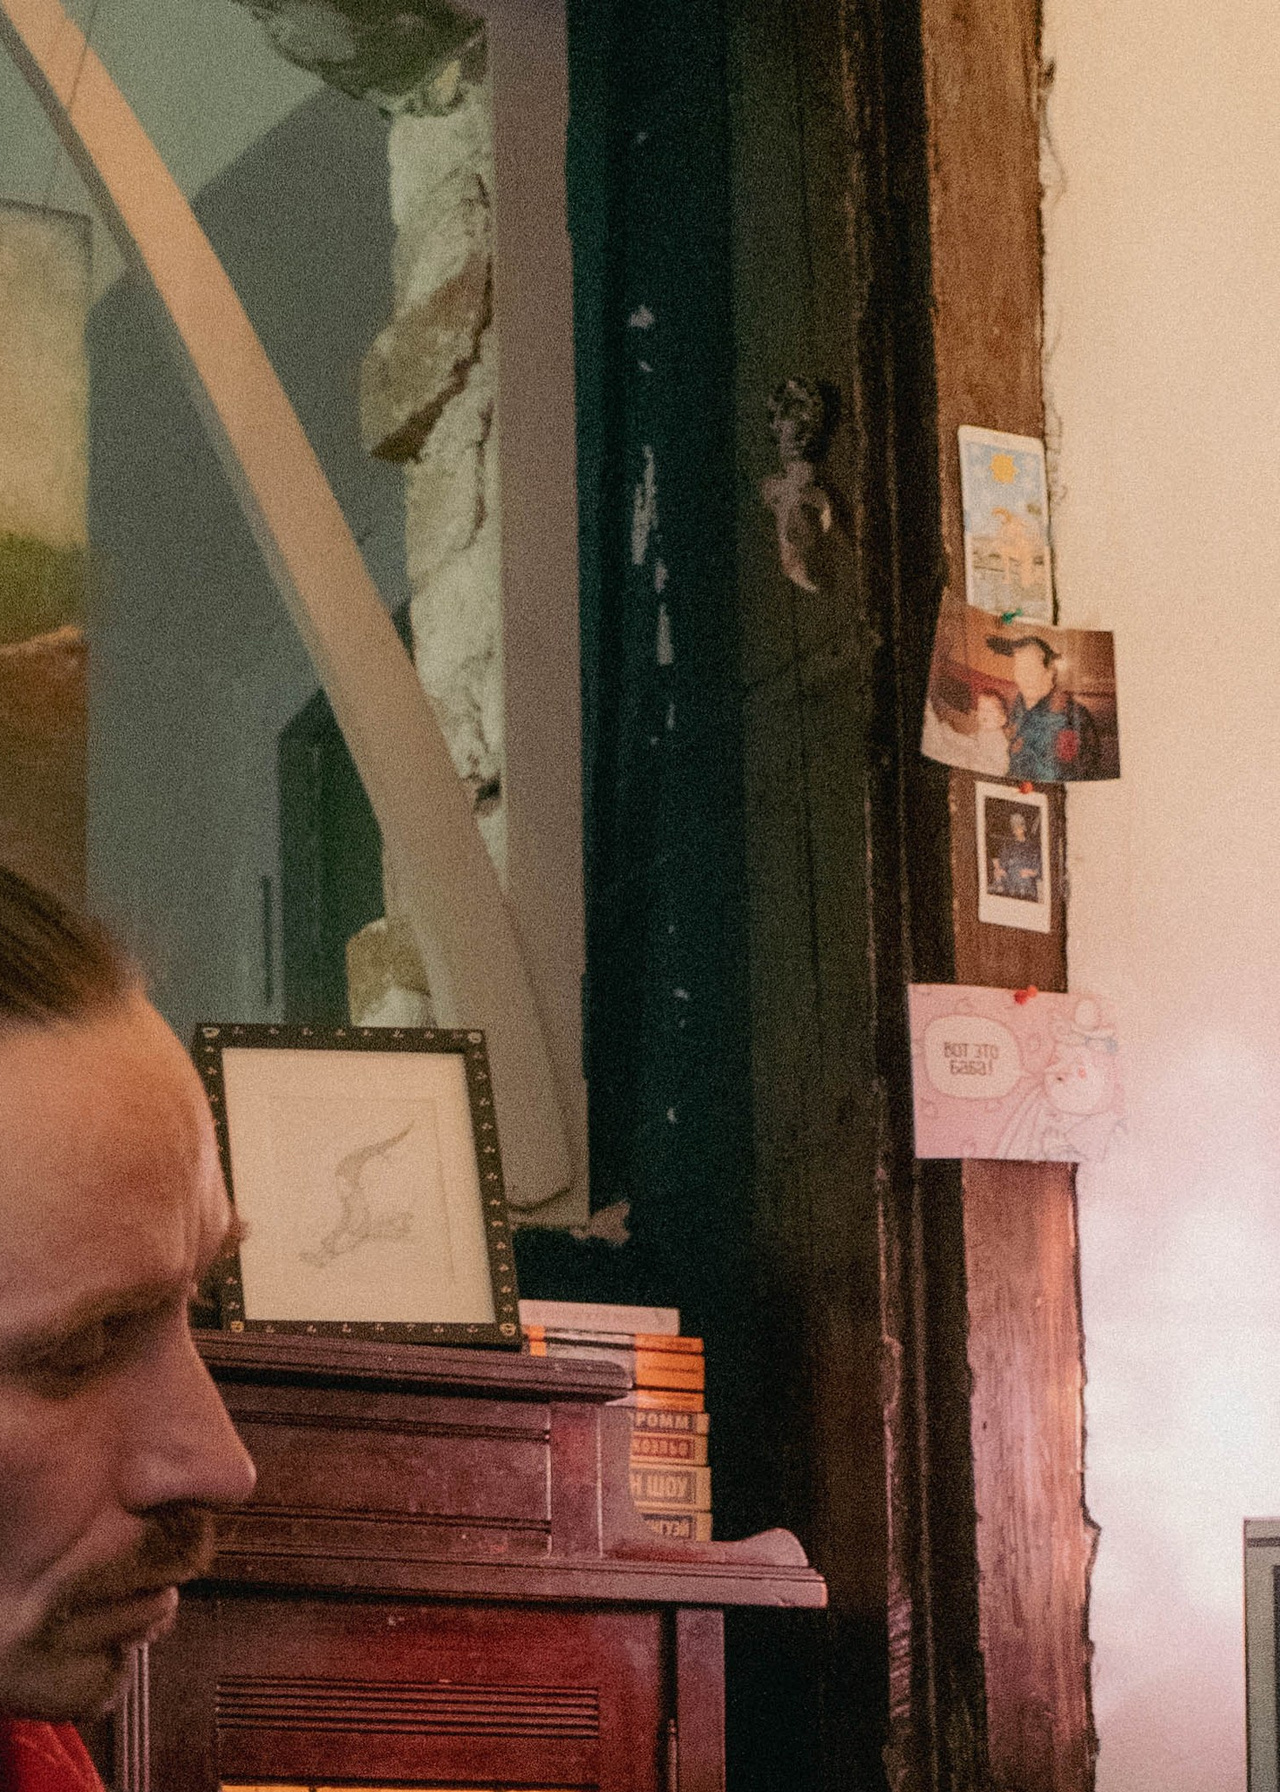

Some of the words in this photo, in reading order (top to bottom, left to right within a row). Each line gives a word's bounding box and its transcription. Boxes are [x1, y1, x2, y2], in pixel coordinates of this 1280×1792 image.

[943, 1041, 968, 1058] ВОТ
[973, 1043, 1000, 1060] ЭТО
[627, 1411, 690, 1430] РОММ
[646, 1474, 689, 1498] ШОУ
